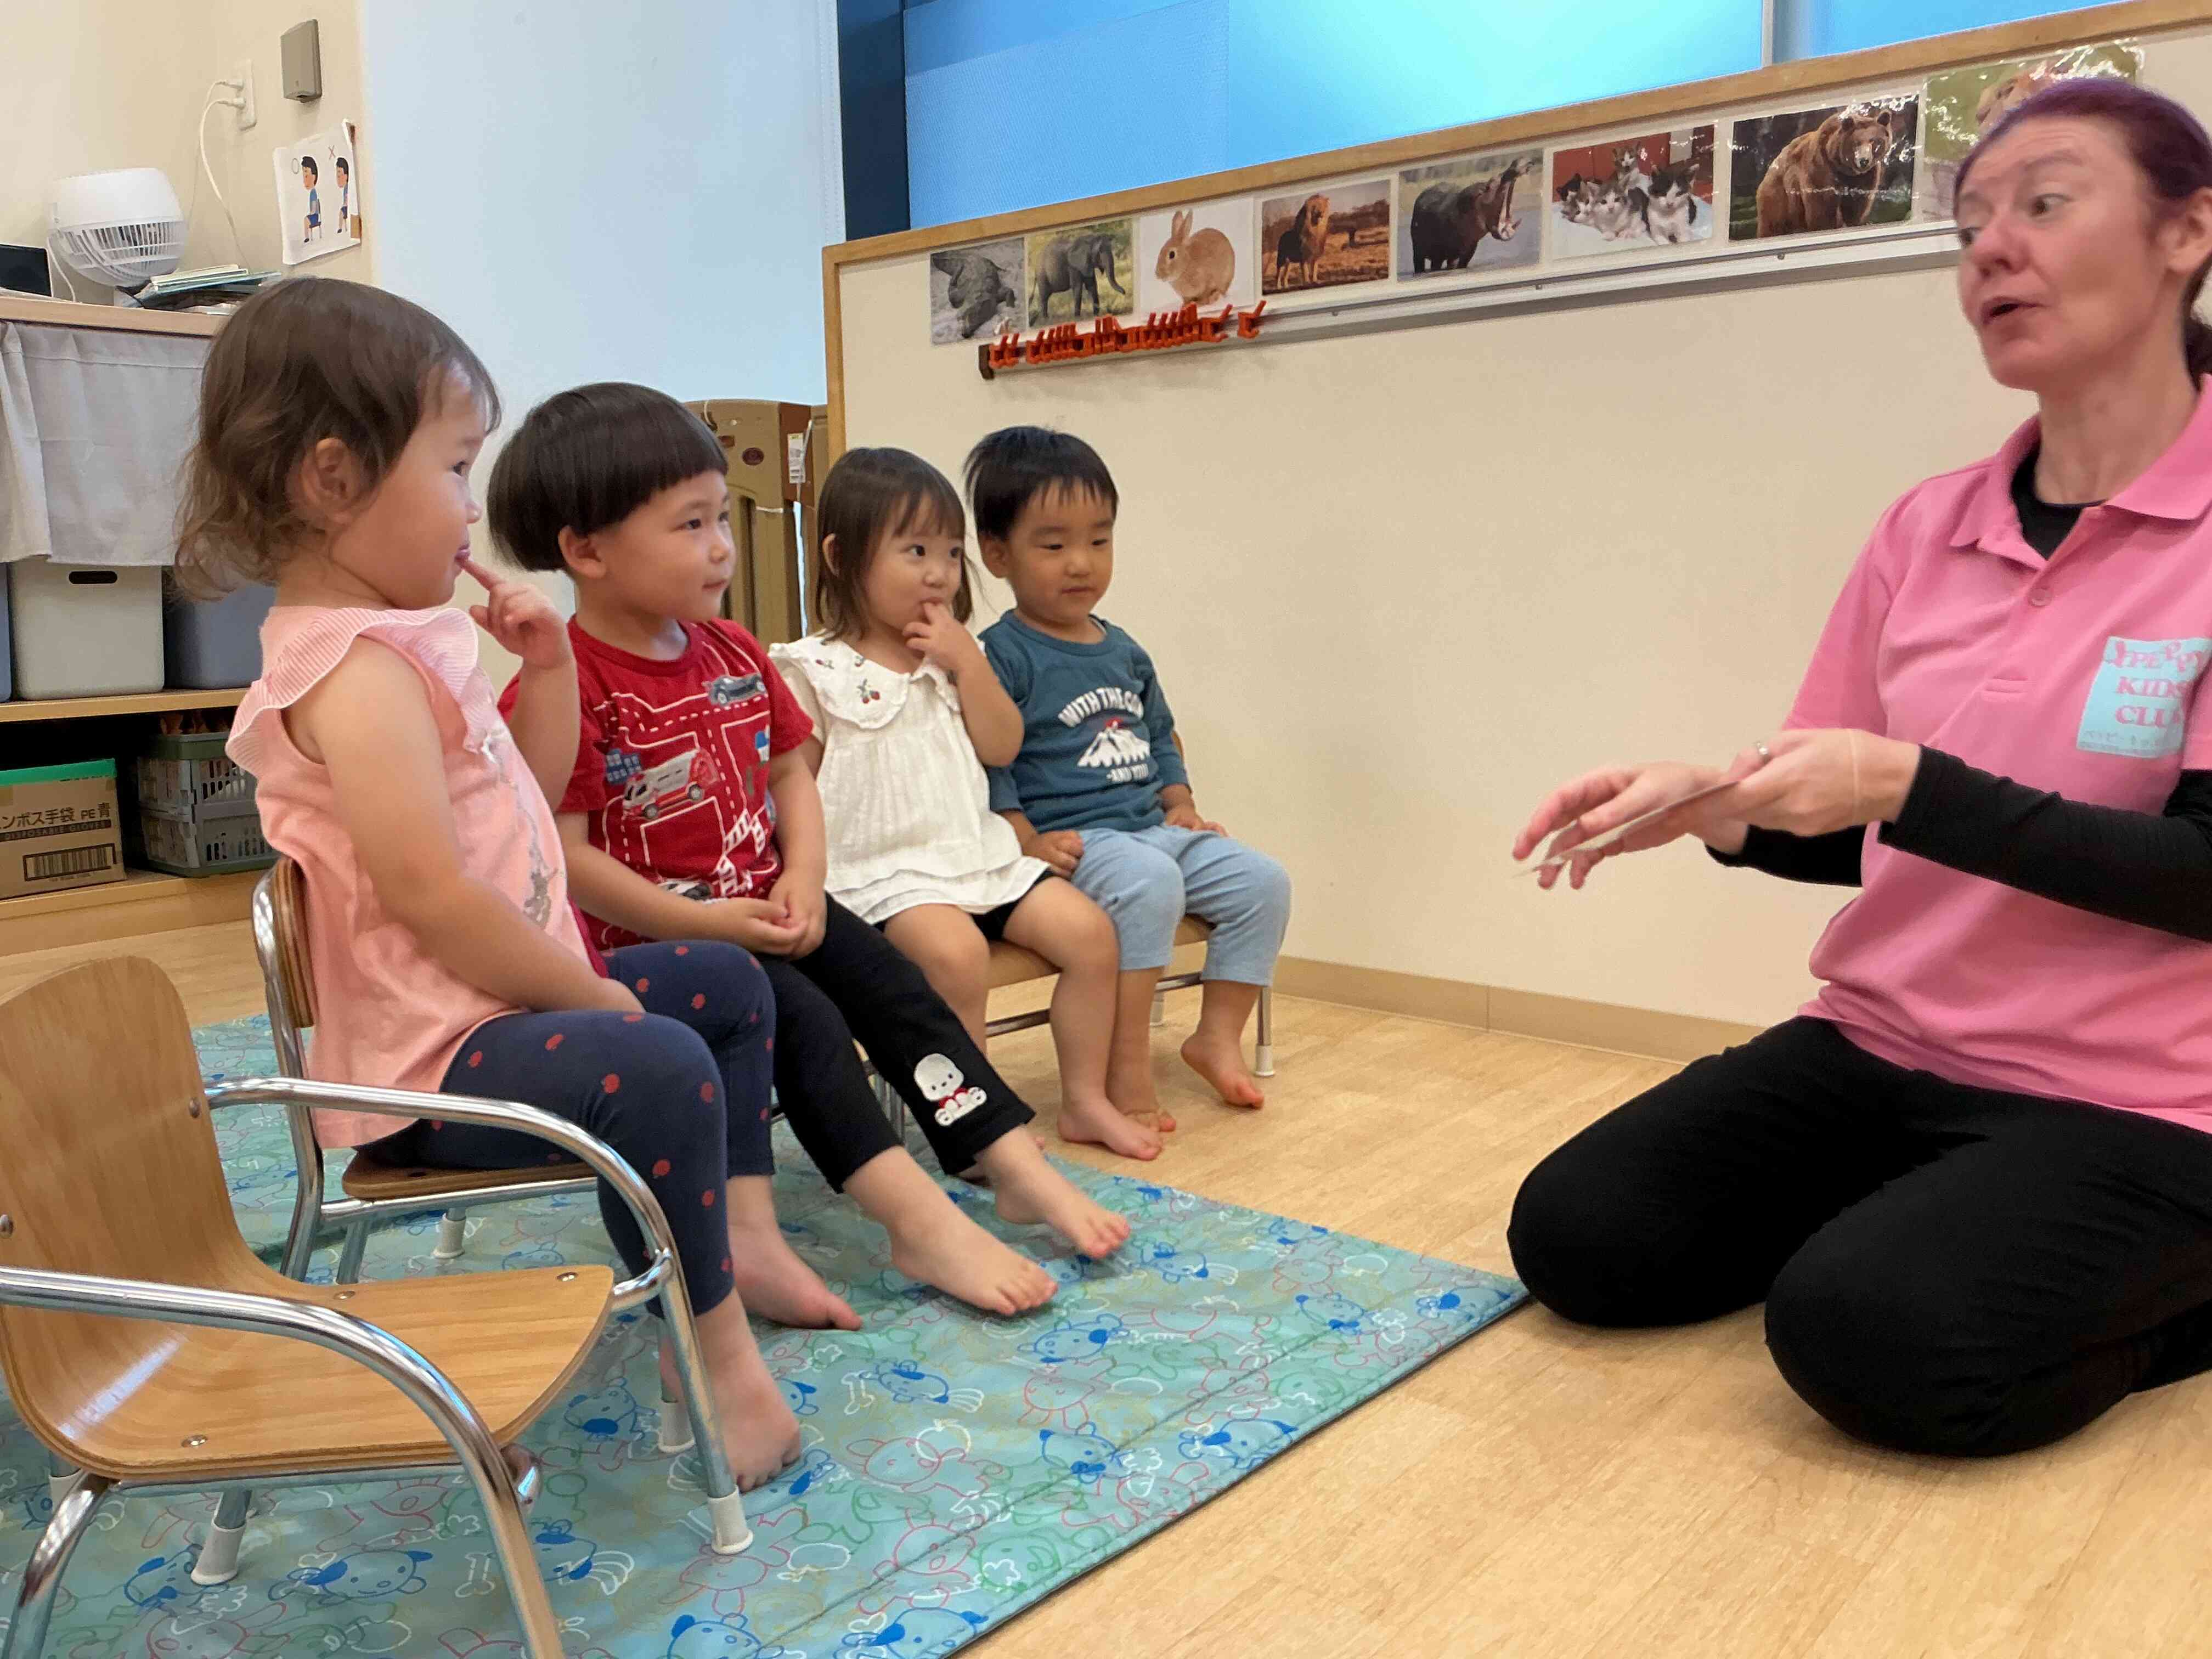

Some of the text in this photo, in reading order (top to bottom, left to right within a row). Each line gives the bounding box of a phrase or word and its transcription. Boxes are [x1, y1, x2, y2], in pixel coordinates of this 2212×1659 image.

[0, 807, 75, 829] ンボス手袋
